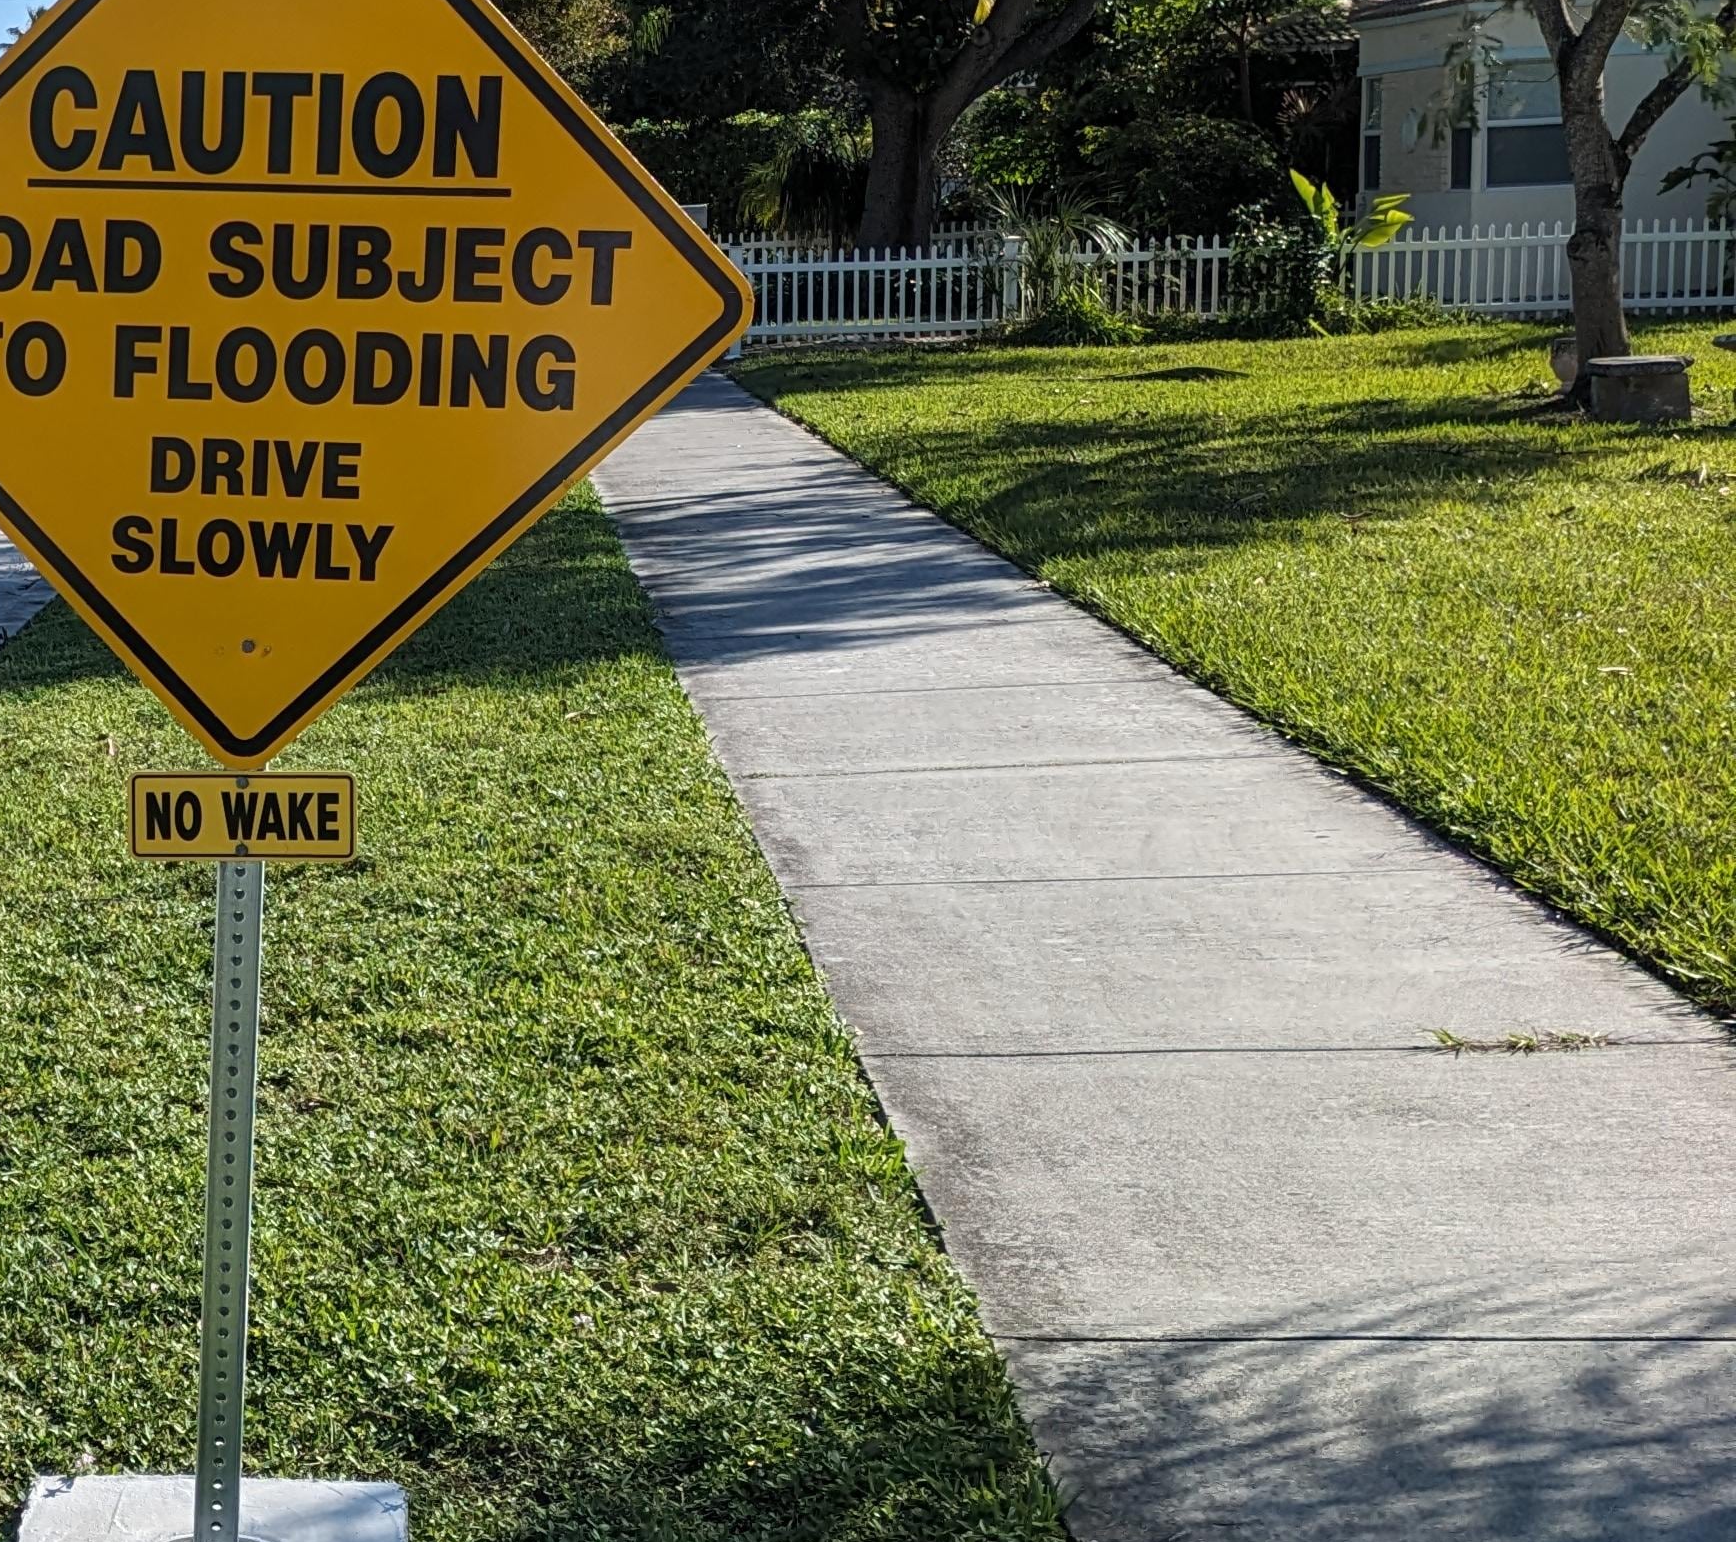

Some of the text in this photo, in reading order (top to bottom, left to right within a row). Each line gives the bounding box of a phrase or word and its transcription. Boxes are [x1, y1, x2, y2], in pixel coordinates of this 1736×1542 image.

[30, 65, 503, 179] CAUTION
[208, 221, 632, 305] SUBJECT
[114, 325, 576, 411] FLOODING
[151, 436, 361, 499] DRIVE
[111, 515, 394, 581] SLOWLY
[146, 791, 339, 841] NO WAKE
